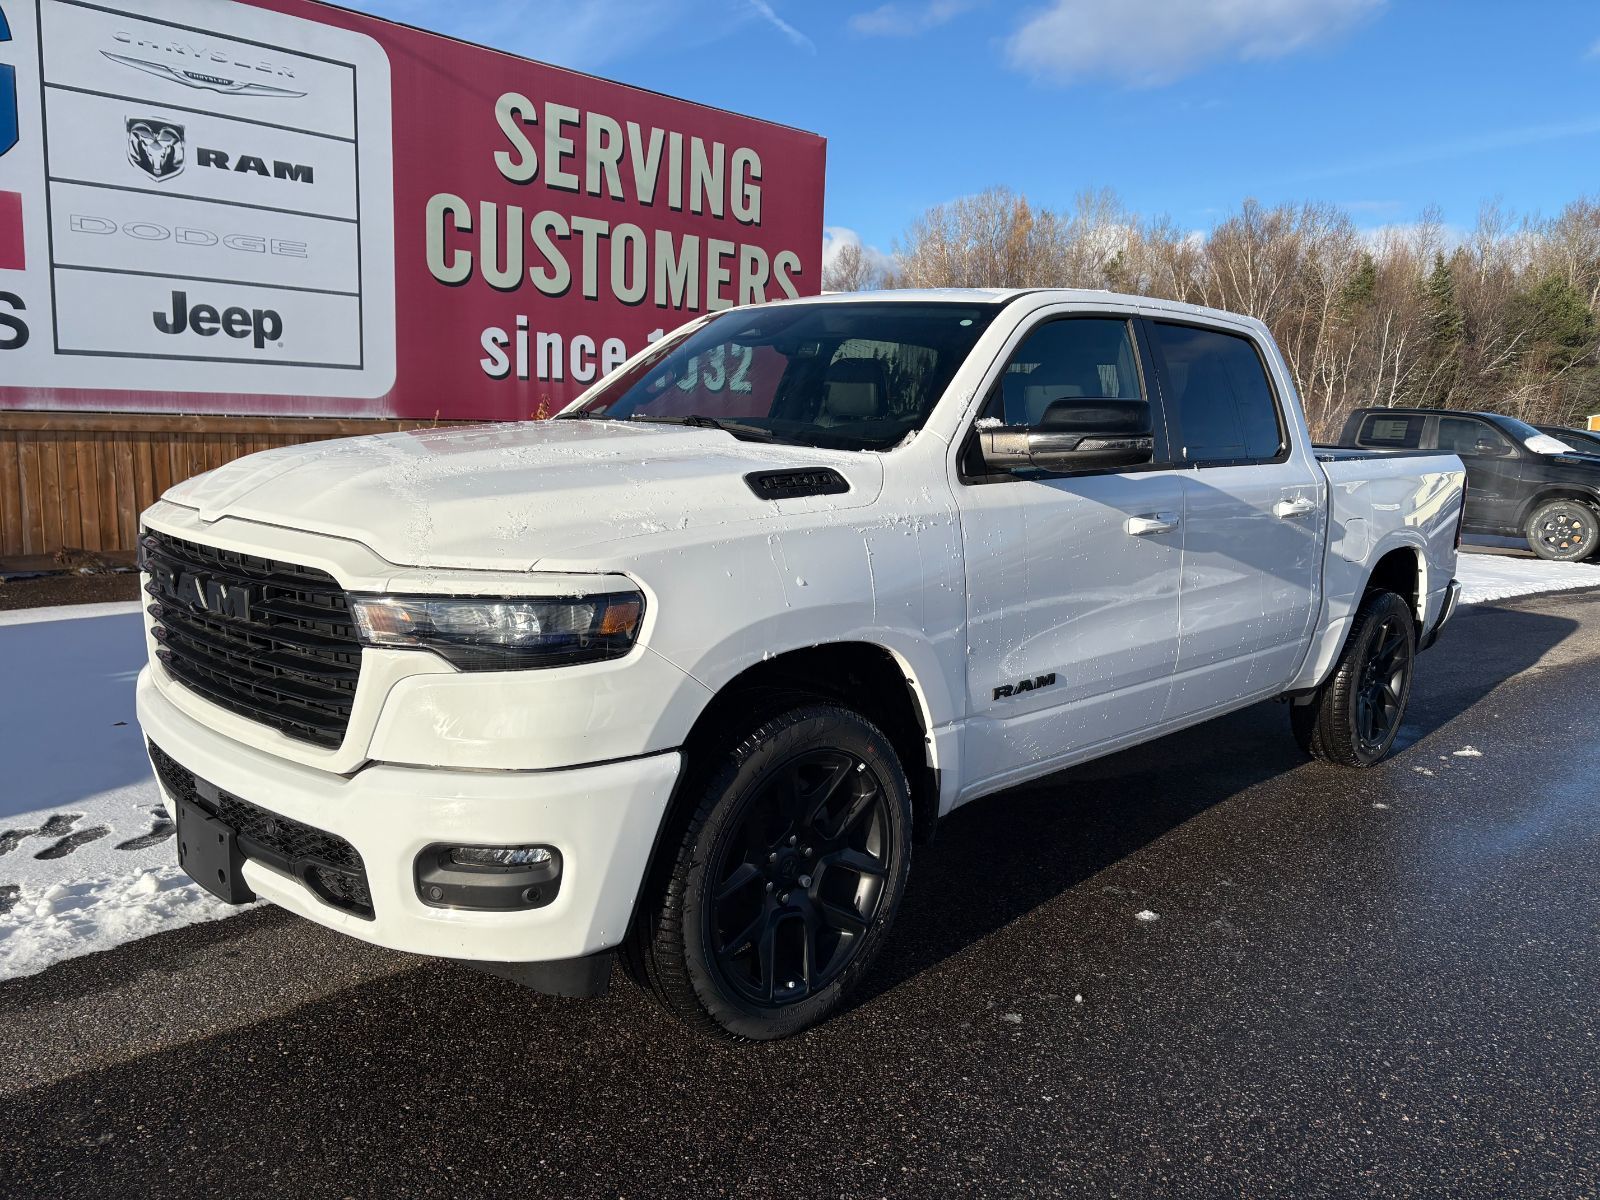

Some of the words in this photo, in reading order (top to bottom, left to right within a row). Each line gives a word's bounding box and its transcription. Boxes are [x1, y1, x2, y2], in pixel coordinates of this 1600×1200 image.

[112, 31, 295, 79] CHRYSLER
[196, 147, 314, 184] RAM
[493, 92, 762, 226] SERVING
[69, 214, 309, 259] DODGE
[425, 192, 802, 311] CUSTOMERS
[152, 290, 283, 348] Jeep
[480, 315, 628, 382] since
[151, 566, 251, 620] RAM
[991, 672, 1057, 700] RAM
